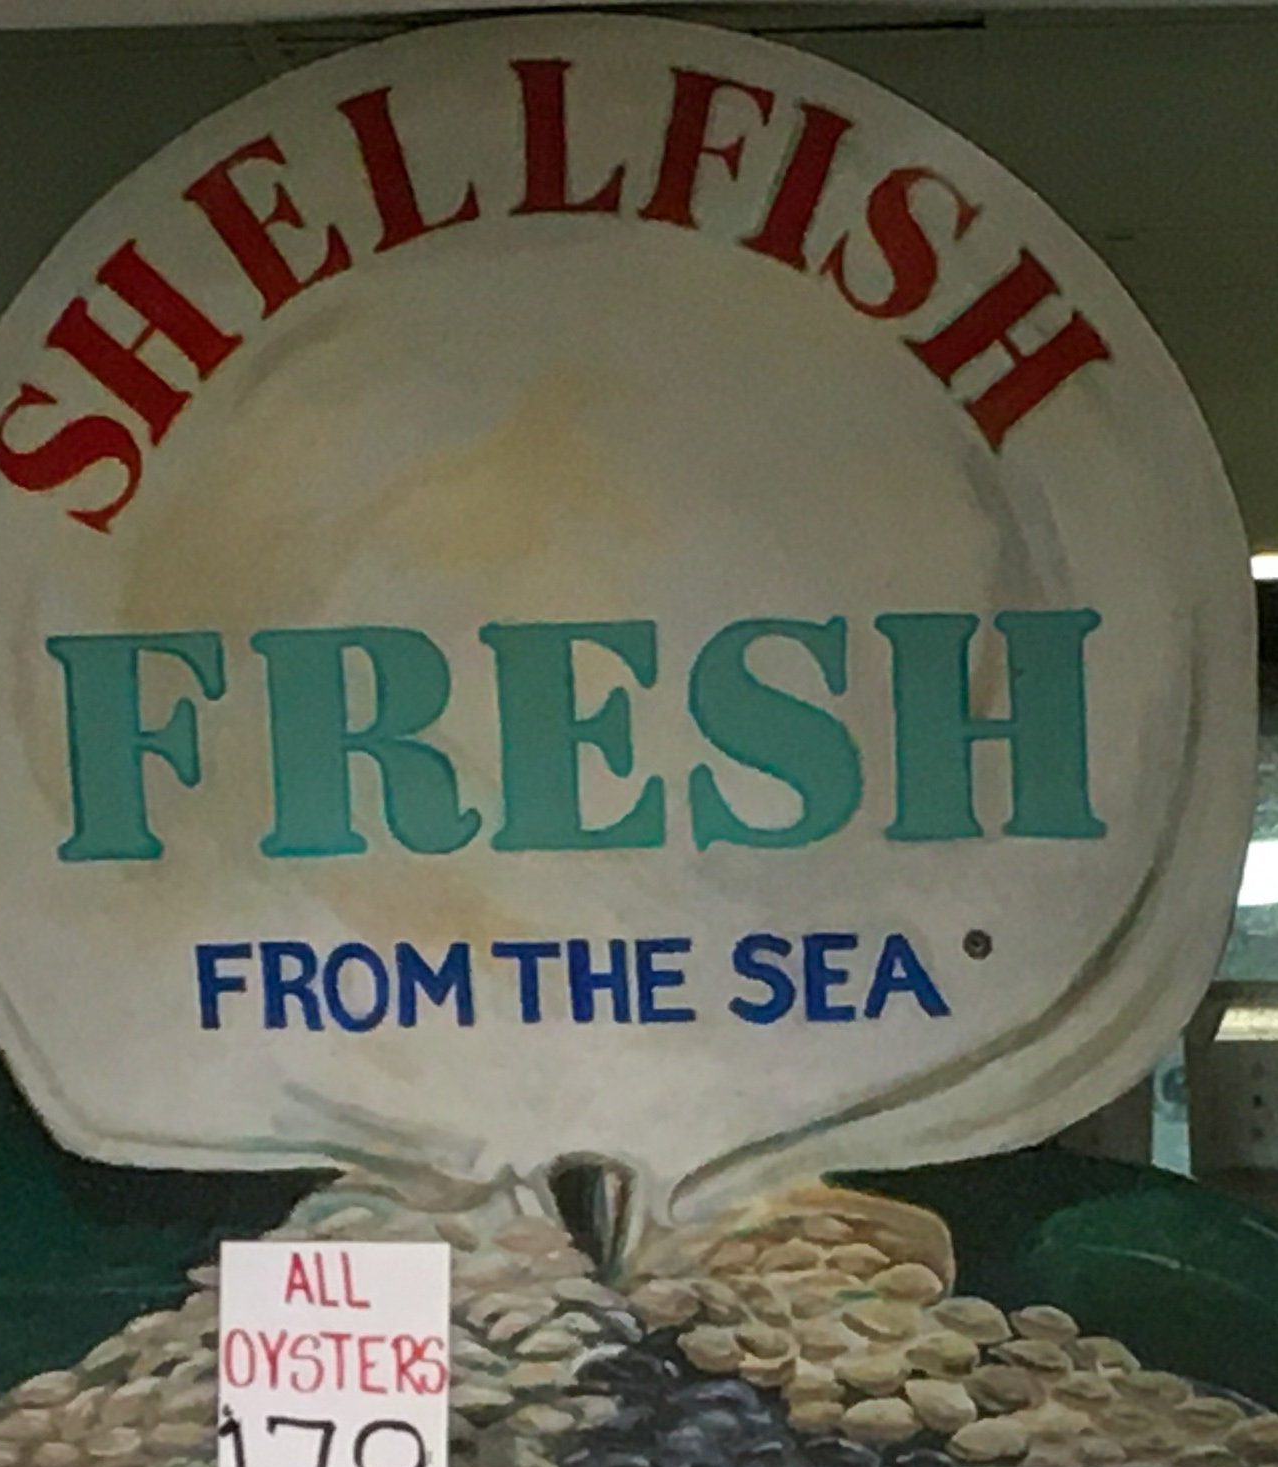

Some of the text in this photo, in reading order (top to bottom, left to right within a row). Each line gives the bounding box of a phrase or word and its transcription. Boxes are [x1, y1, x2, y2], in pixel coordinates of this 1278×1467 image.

[45, 608, 1107, 863] FRESH
[193, 932, 951, 1033] FROM THE SEA
[284, 1251, 371, 1309] ALL
[224, 1327, 449, 1396] OYSTERS
